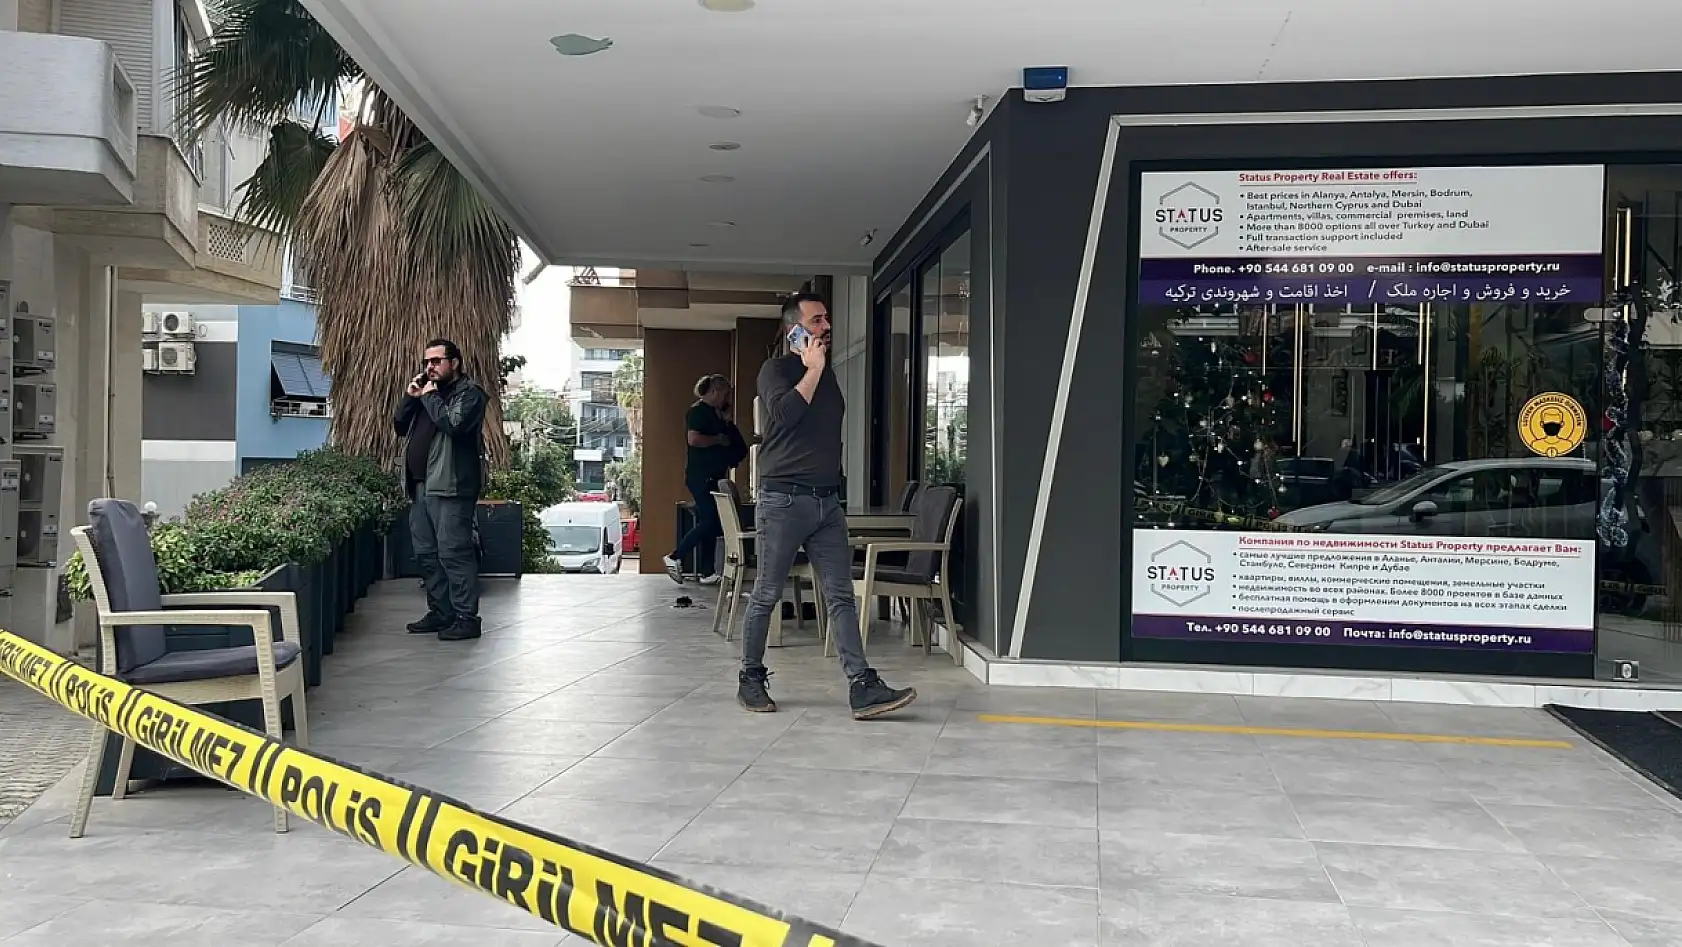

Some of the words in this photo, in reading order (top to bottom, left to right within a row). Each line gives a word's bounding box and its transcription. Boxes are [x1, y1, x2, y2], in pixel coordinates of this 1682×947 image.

[1239, 173, 1271, 181] Status
[1274, 173, 1318, 182] Property
[1321, 172, 1344, 180] Real
[1347, 172, 1380, 180] Estate
[1383, 170, 1417, 179] offers:
[1246, 191, 1268, 200] Best
[1270, 191, 1298, 200] prices
[1301, 191, 1310, 199] in
[1312, 191, 1348, 200] Alanya,
[1350, 190, 1389, 199] Antalya,
[1391, 189, 1428, 198] Mersin,
[1430, 188, 1473, 198] Bodrum,
[1246, 202, 1288, 211] Istanbul,
[1290, 201, 1333, 210] Northern
[1335, 201, 1369, 210] Cyprus
[1371, 200, 1390, 208] and
[1392, 200, 1422, 208] Dubai
[1155, 208, 1223, 223] STATUS
[1246, 213, 1304, 222] Apartments,
[1306, 212, 1333, 220] villas,
[1336, 211, 1392, 219] commercial
[1397, 211, 1444, 220] premises,
[1446, 210, 1469, 218] land
[1274, 223, 1296, 231] than
[1325, 222, 1362, 231] options
[1364, 222, 1376, 230] all
[1402, 221, 1435, 231] Turkey
[1437, 221, 1456, 229] and
[1459, 220, 1490, 229] Dubai
[1266, 233, 1318, 241] transaction
[1321, 233, 1359, 242] support
[1360, 232, 1403, 240] included
[1294, 244, 1327, 252] service
[1194, 264, 1235, 274] Phone.
[1238, 264, 1261, 273] +90
[1265, 264, 1288, 273] 544
[1292, 264, 1314, 273] 681
[1319, 264, 1335, 273] 09
[1338, 263, 1354, 272] 00
[1367, 262, 1405, 272] e-mail
[1416, 262, 1560, 274] info@statusproperty.ru
[1165, 284, 1197, 301] ترکیه
[1201, 284, 1260, 301] شهروندی
[1265, 288, 1274, 300] و
[1278, 284, 1318, 298] اقامت
[1323, 284, 1348, 299] اخذ
[1387, 283, 1417, 297] ملک
[1423, 283, 1457, 299] اجاره
[1462, 288, 1470, 299] و
[1475, 283, 1516, 300] فروش
[1522, 288, 1531, 299] و
[1536, 283, 1571, 300] خرید
[1239, 537, 1295, 545] Компания
[1312, 540, 1398, 548] недвижимости
[1400, 540, 1433, 549] Status
[1436, 541, 1485, 552] Property
[1486, 544, 1551, 553] предлагает
[1554, 544, 1582, 553] Вам:
[1147, 566, 1215, 581] STATUS
[1186, 622, 1212, 632] Тел.
[1215, 624, 1239, 633] +90
[1242, 624, 1265, 634] 544
[1268, 625, 1291, 635] 681
[1296, 626, 1312, 635] 09
[1314, 627, 1331, 636] 00
[1343, 627, 1386, 638] Почта:
[1388, 629, 1532, 645] info@statusproperty.ru
